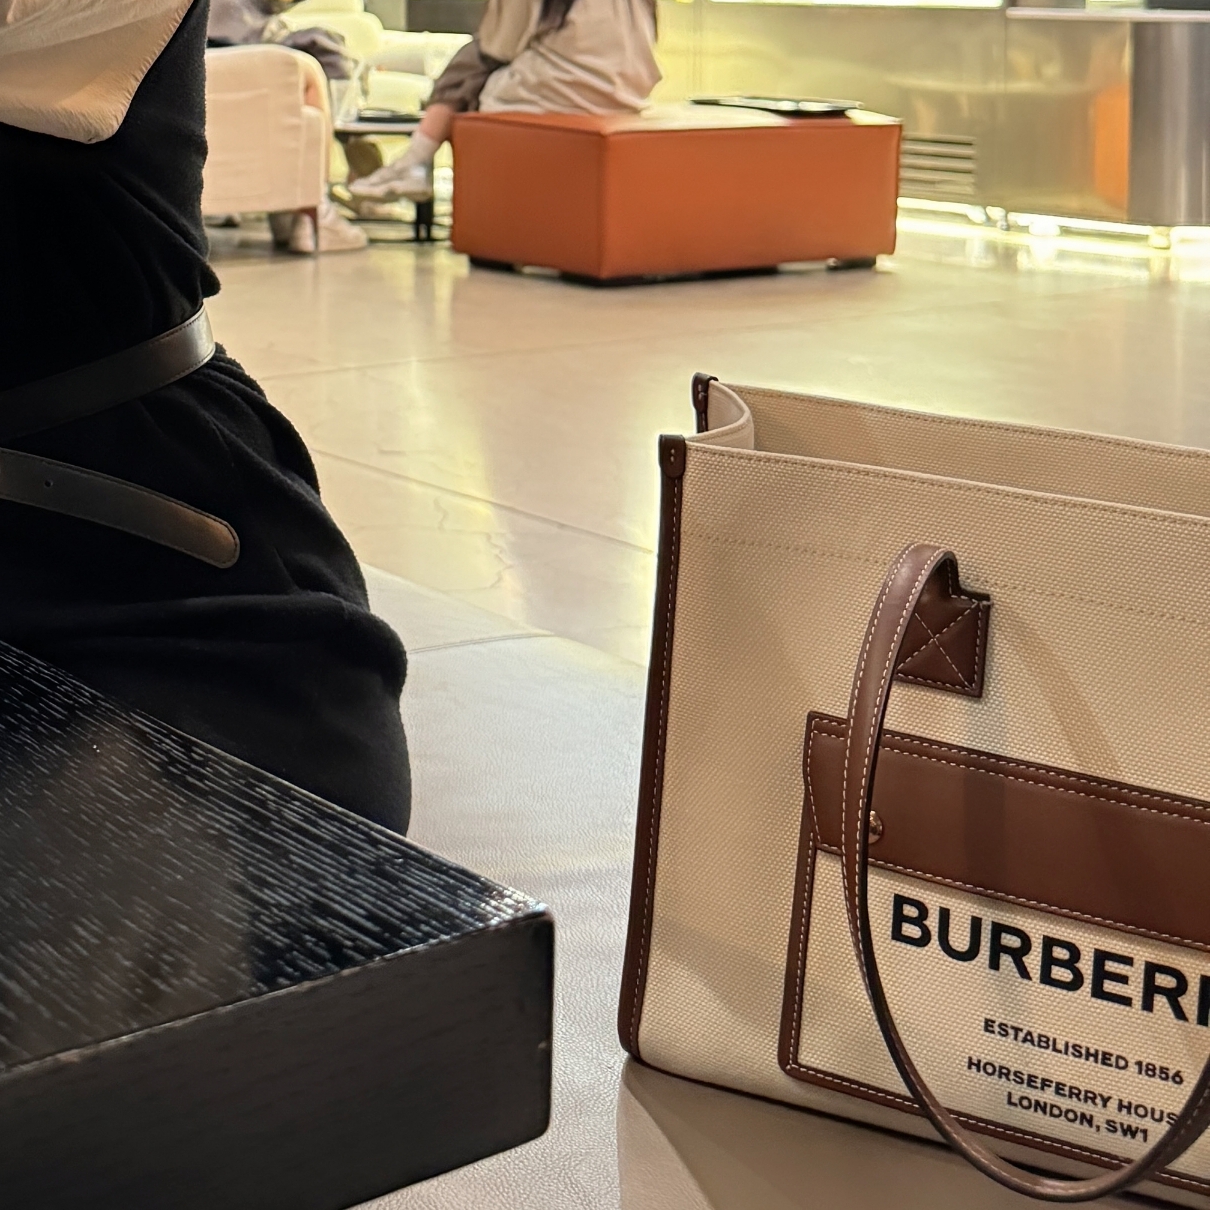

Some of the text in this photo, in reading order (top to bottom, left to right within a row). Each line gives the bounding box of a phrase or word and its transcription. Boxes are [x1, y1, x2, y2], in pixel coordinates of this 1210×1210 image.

[983, 1018, 1184, 1085] ESTABLISHED 1856
[967, 1056, 1179, 1125] HORSEFERRY HOUS
[1006, 1092, 1148, 1143] LONDON, SW1
